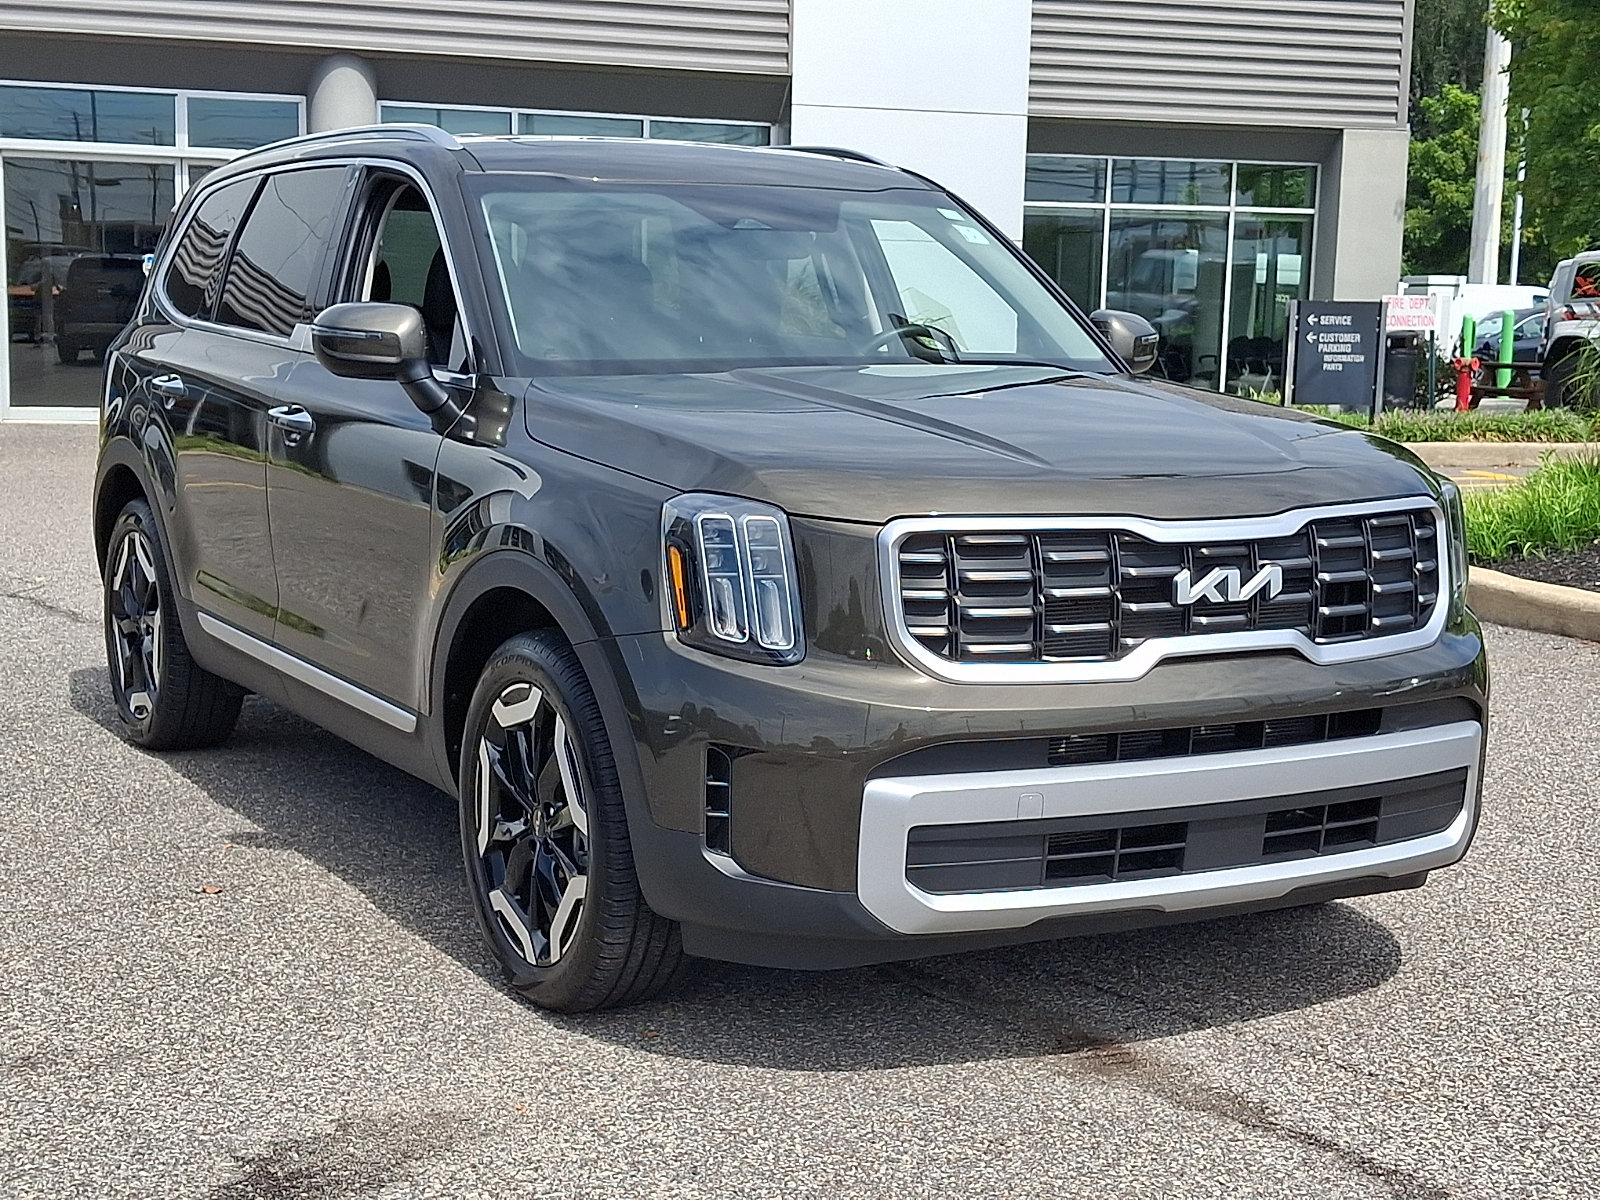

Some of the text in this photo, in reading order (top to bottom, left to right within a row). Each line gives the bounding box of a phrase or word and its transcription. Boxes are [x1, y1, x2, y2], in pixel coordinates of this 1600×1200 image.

[1387, 296, 1405, 310] FIRE
[1319, 315, 1352, 326] SERVICE
[1318, 332, 1361, 343] CUSTOMER
[1317, 343, 1352, 353] PARKING
[1322, 363, 1343, 371] PARTS
